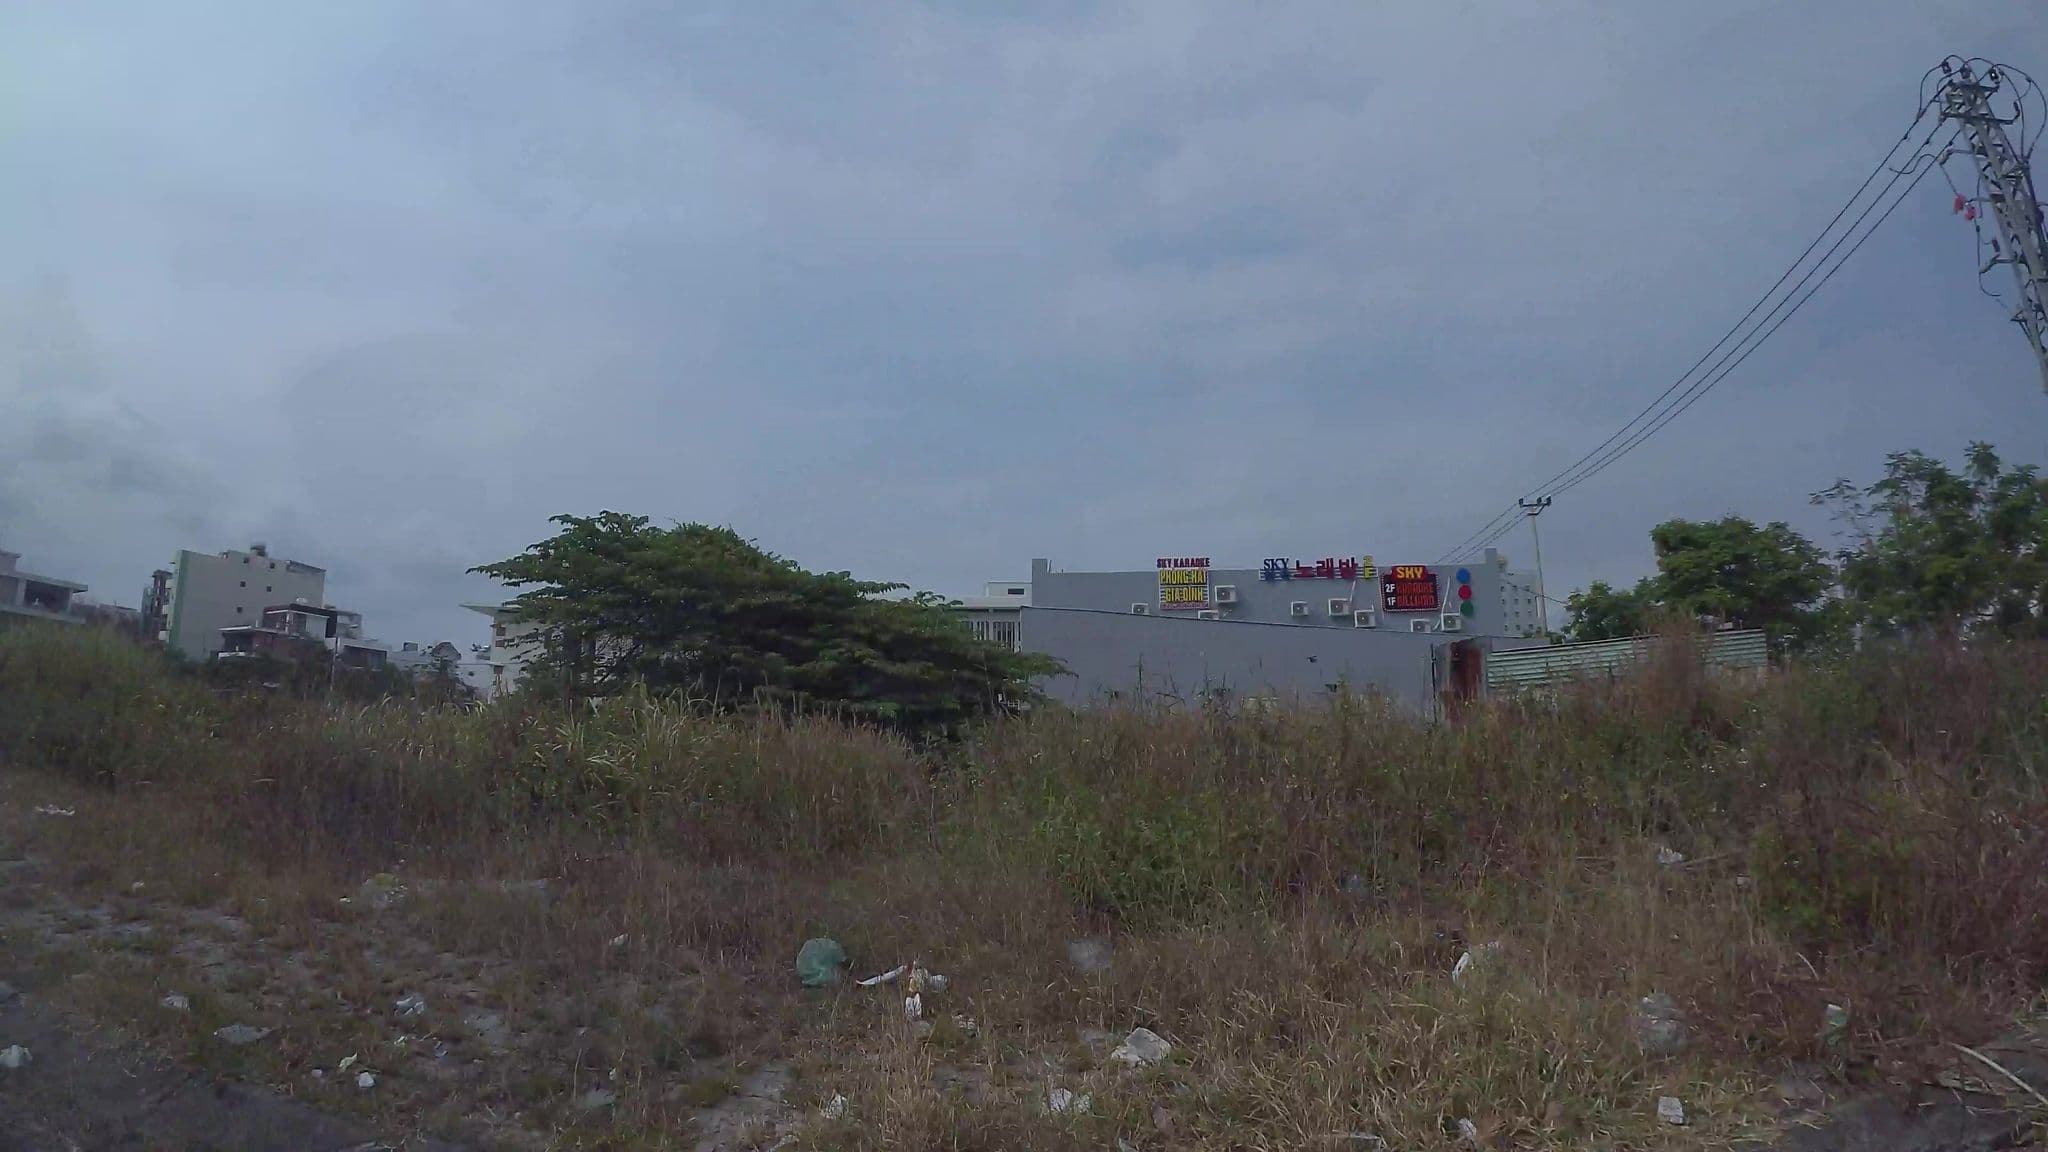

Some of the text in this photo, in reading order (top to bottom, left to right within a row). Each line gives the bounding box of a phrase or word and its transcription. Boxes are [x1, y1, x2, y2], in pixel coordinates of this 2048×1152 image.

[1157, 557, 1210, 568] SKY KARAOKE
[1263, 558, 1289, 570] SKY
[1294, 557, 1359, 579] 노래방
[1384, 583, 1396, 593] 2F
[1387, 596, 1396, 606] 1F
